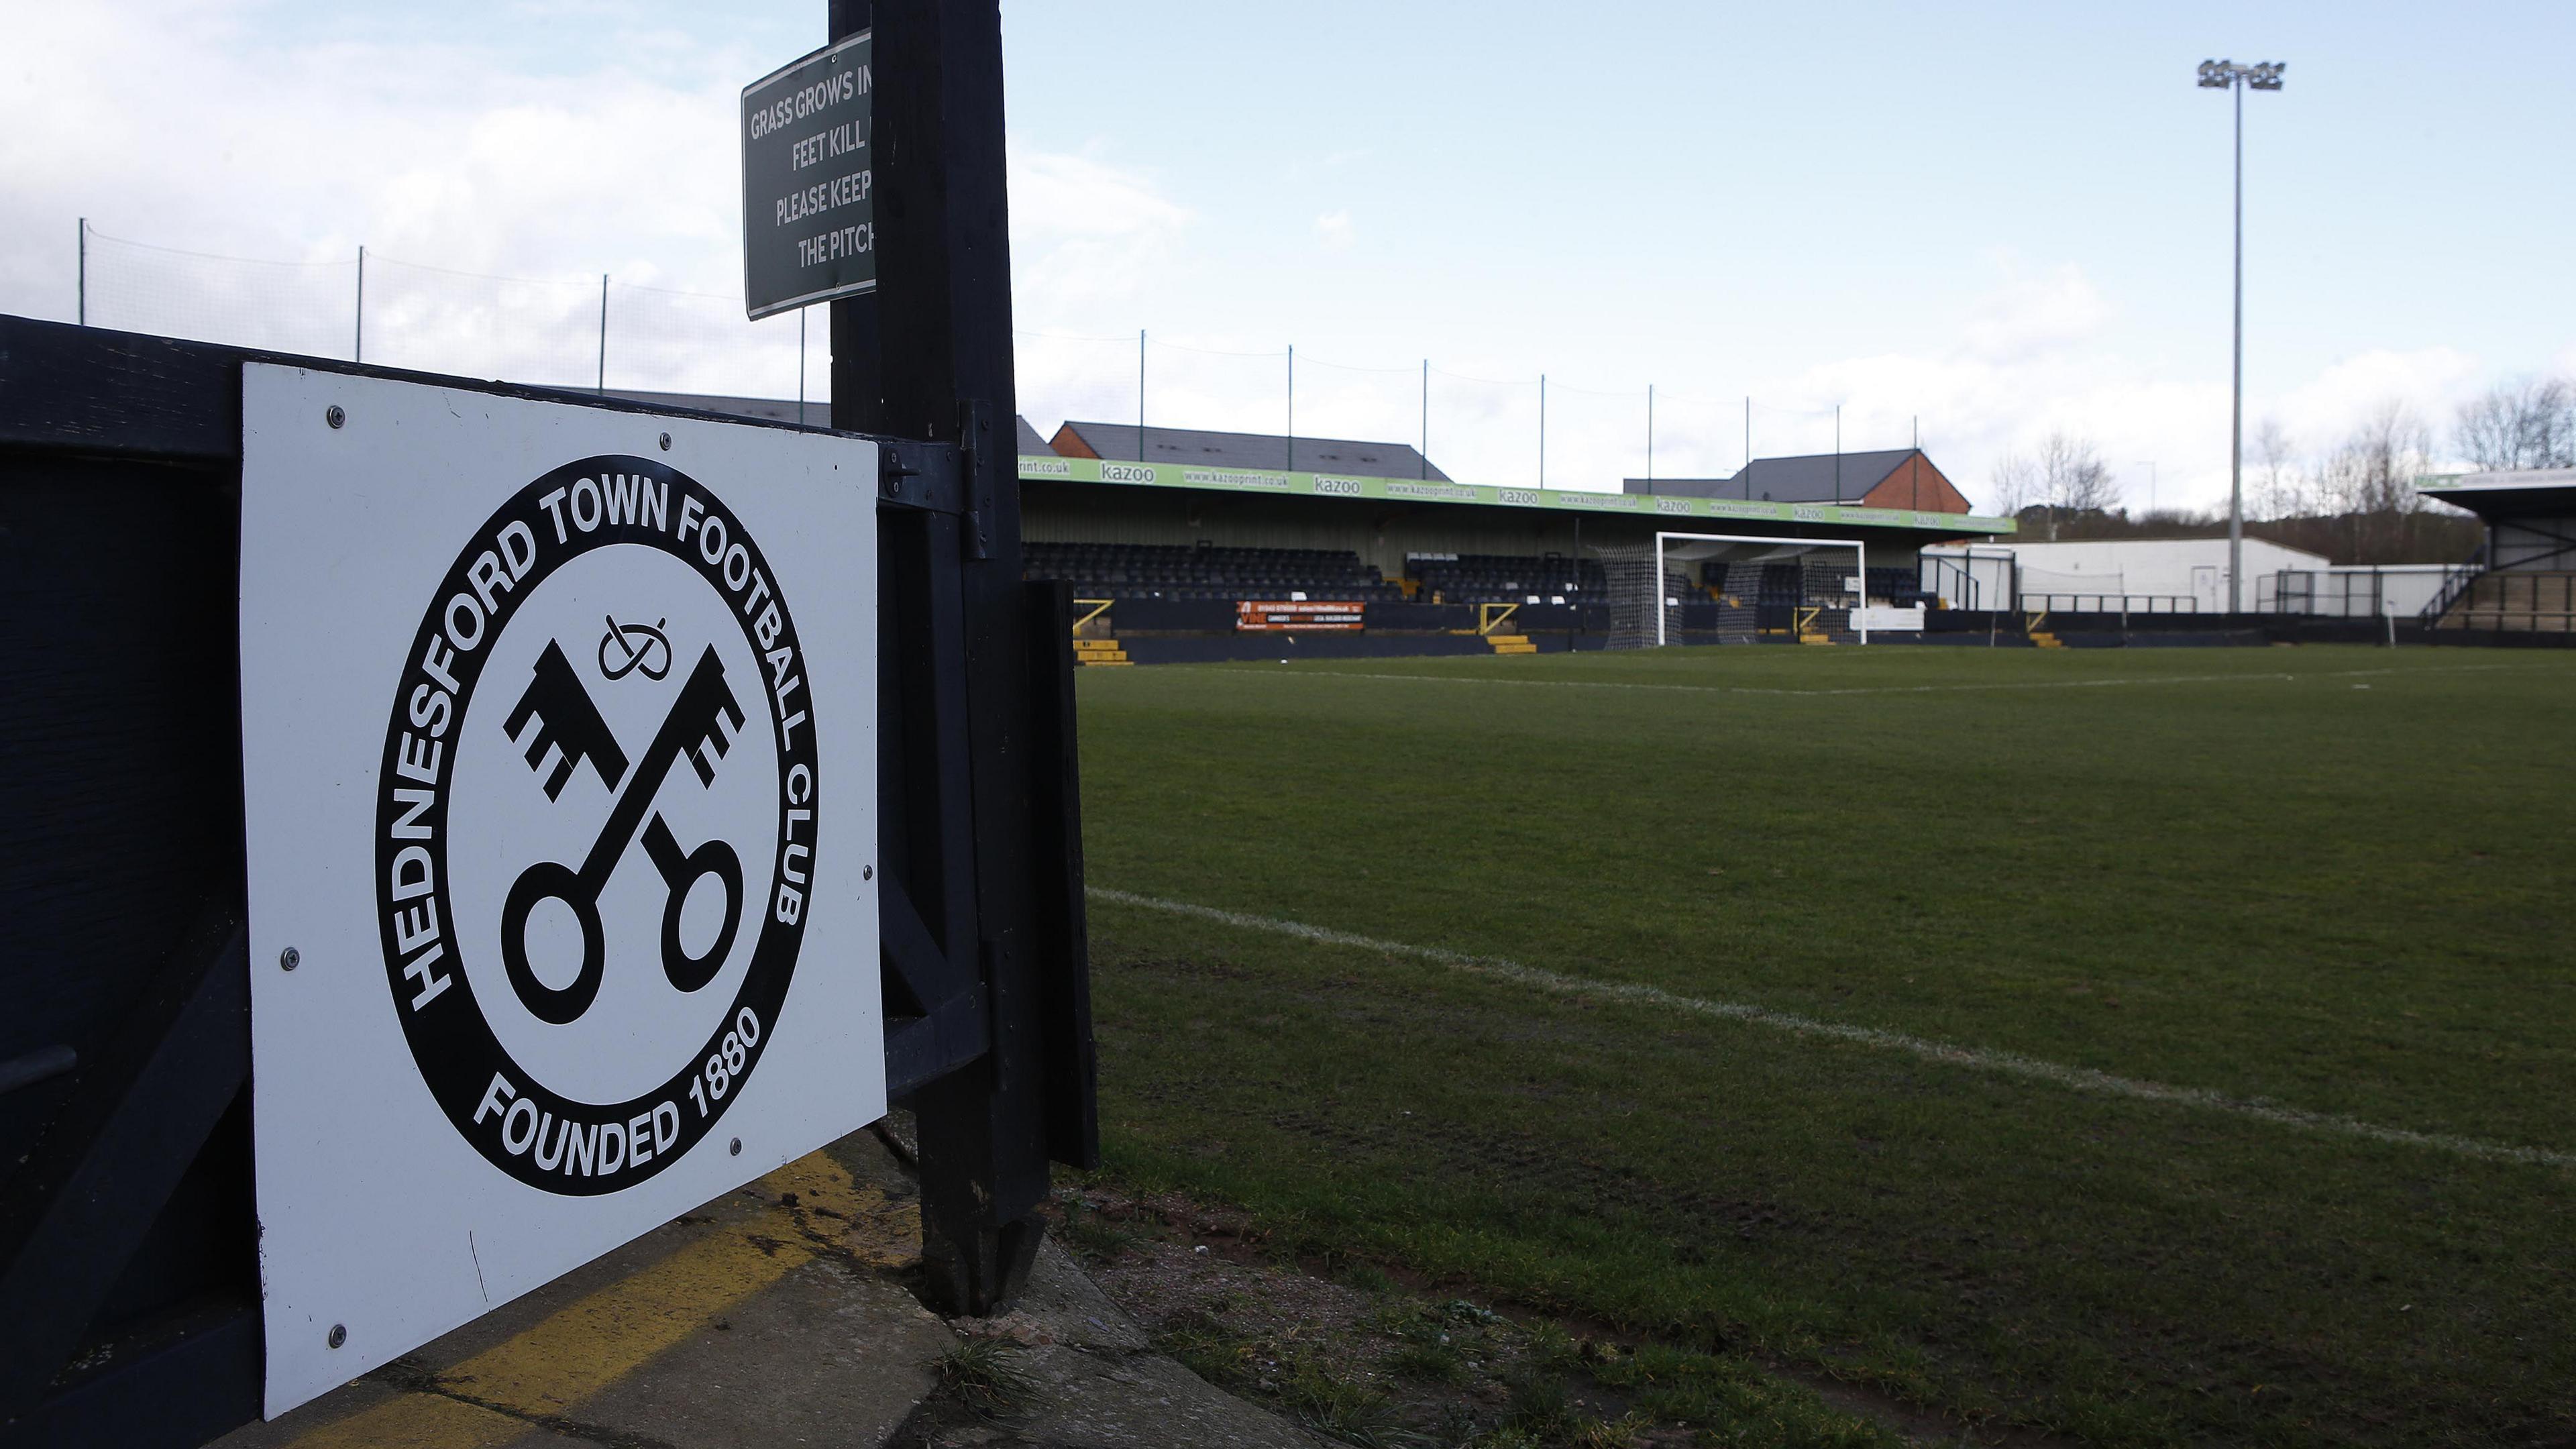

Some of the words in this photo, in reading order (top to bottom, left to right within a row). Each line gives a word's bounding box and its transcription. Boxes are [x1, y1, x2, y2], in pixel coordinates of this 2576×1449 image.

[751, 96, 793, 140] GRASS
[796, 70, 853, 120] GROWS
[793, 131, 826, 171] FEET
[830, 120, 865, 157] KILL
[777, 182, 827, 227] PLEASE
[830, 169, 871, 209] KEEP
[798, 233, 826, 268] THE
[1101, 462, 1155, 482] kazoo
[1184, 471, 1289, 487] www.kazooprint.co.uk
[1313, 476, 1360, 495] kazoo
[1499, 488, 1538, 505] kazoo
[1656, 496, 1690, 513] kazoo
[392, 520, 537, 1012] HEDNESFORD
[539, 474, 668, 545] TOWN
[677, 494, 805, 752] FOOTBALL
[776, 763, 811, 926] CLUB
[474, 1071, 680, 1176] FOUNDED
[689, 1007, 760, 1118] 1880
